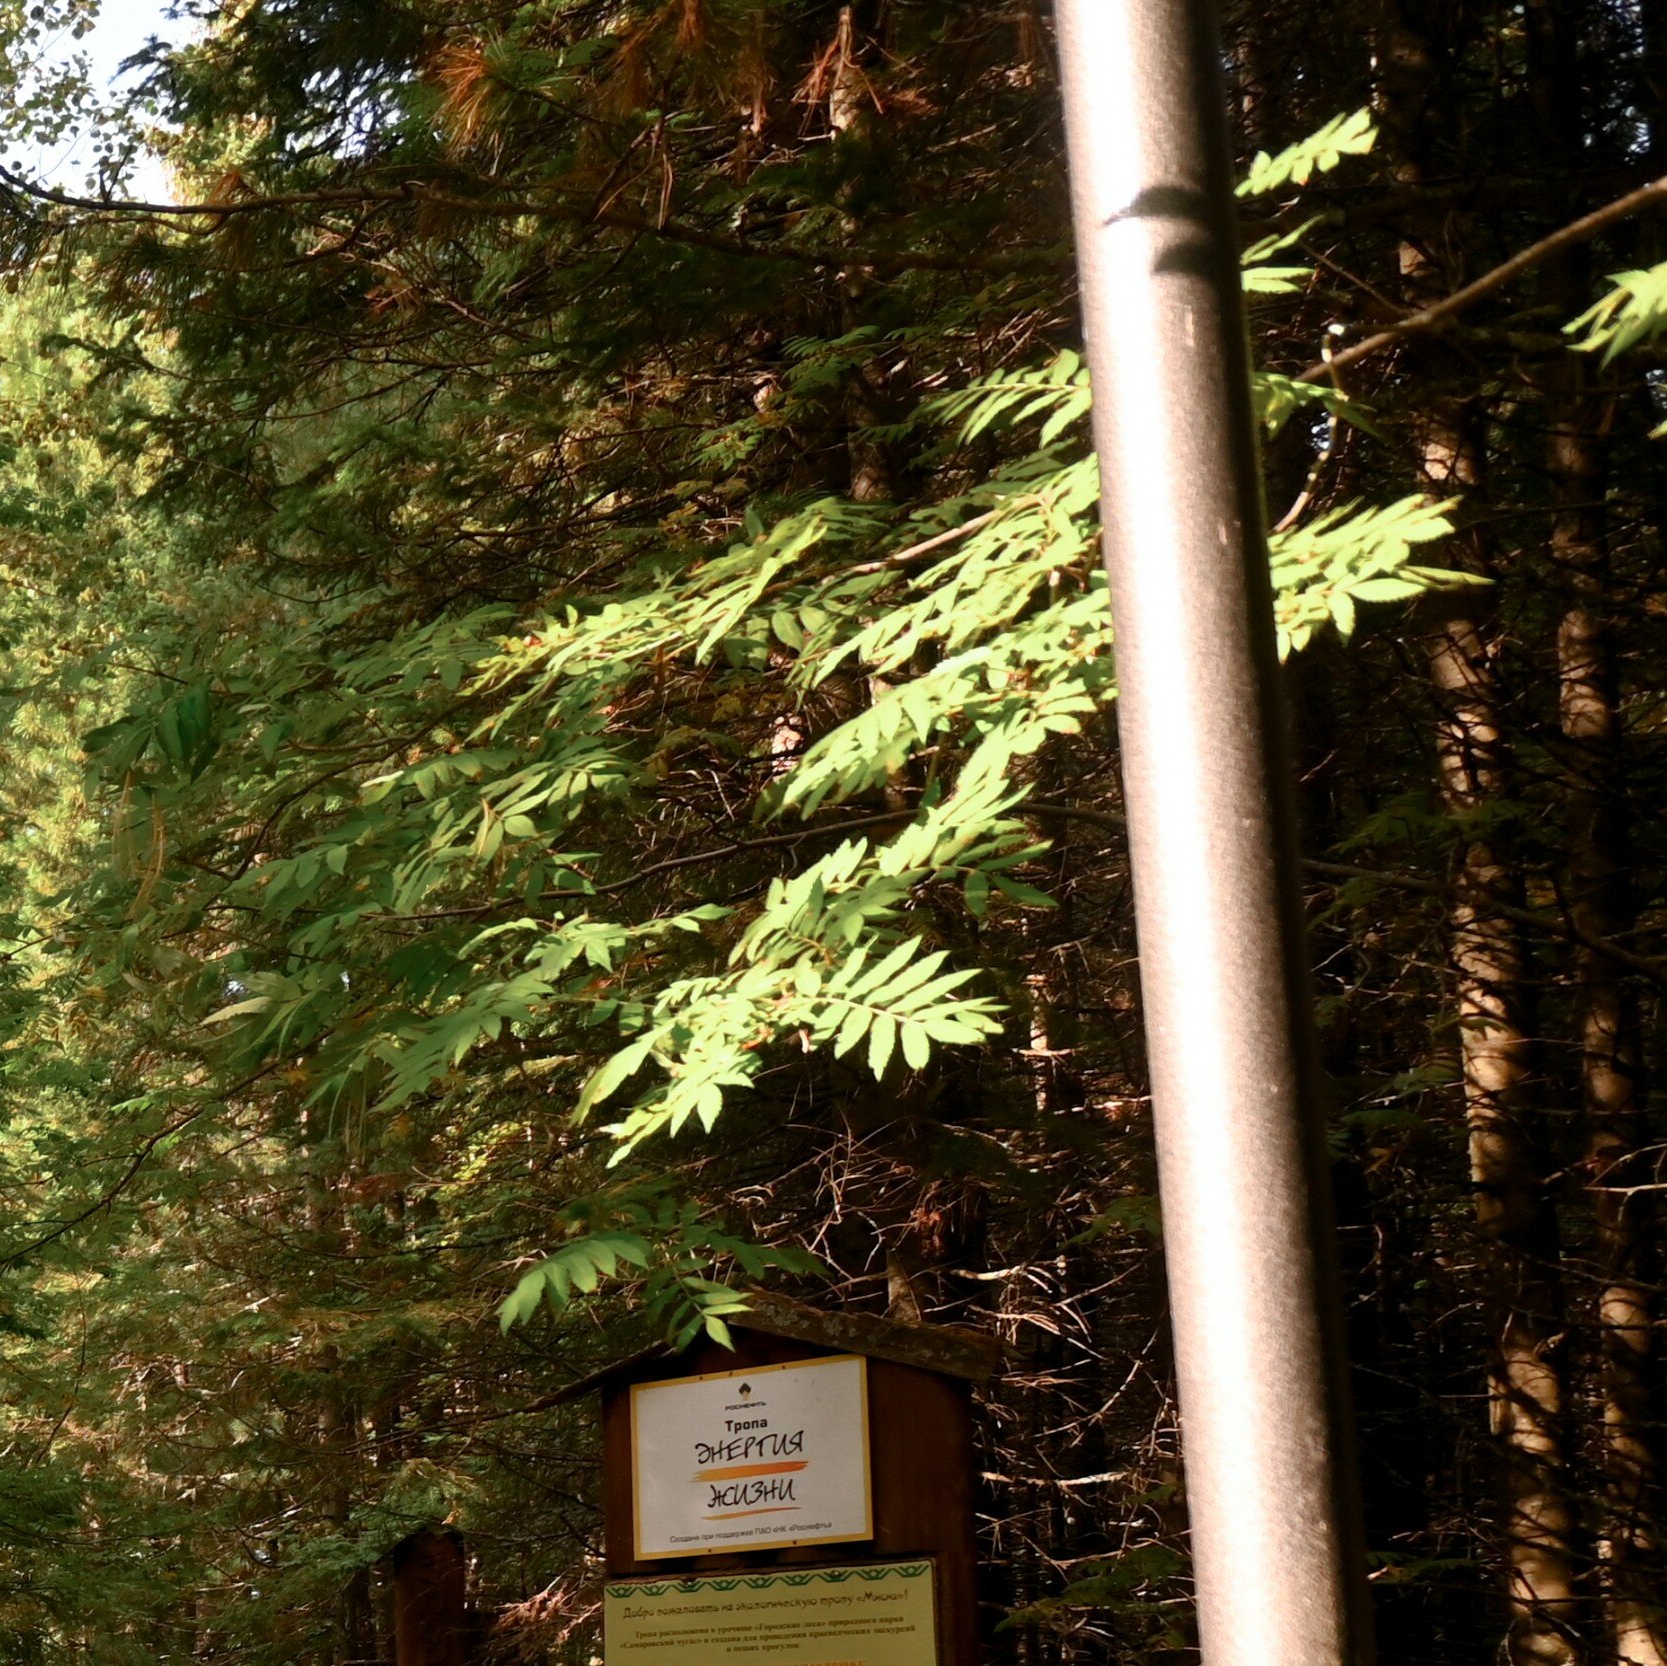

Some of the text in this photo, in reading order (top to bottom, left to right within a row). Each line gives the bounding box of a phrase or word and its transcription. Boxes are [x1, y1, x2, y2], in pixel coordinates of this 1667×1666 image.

[724, 1401, 767, 1411] РОСНЕФТЬ
[724, 1418, 768, 1434] Тропа
[694, 1430, 804, 1465] ЭНЕРГИЯ
[707, 1478, 796, 1508] ЖИЗНИ
[670, 1534, 700, 1543] Создана
[755, 1527, 772, 1535] ПАО
[623, 1606, 655, 1620] Добро
[820, 1597, 853, 1607] тропу
